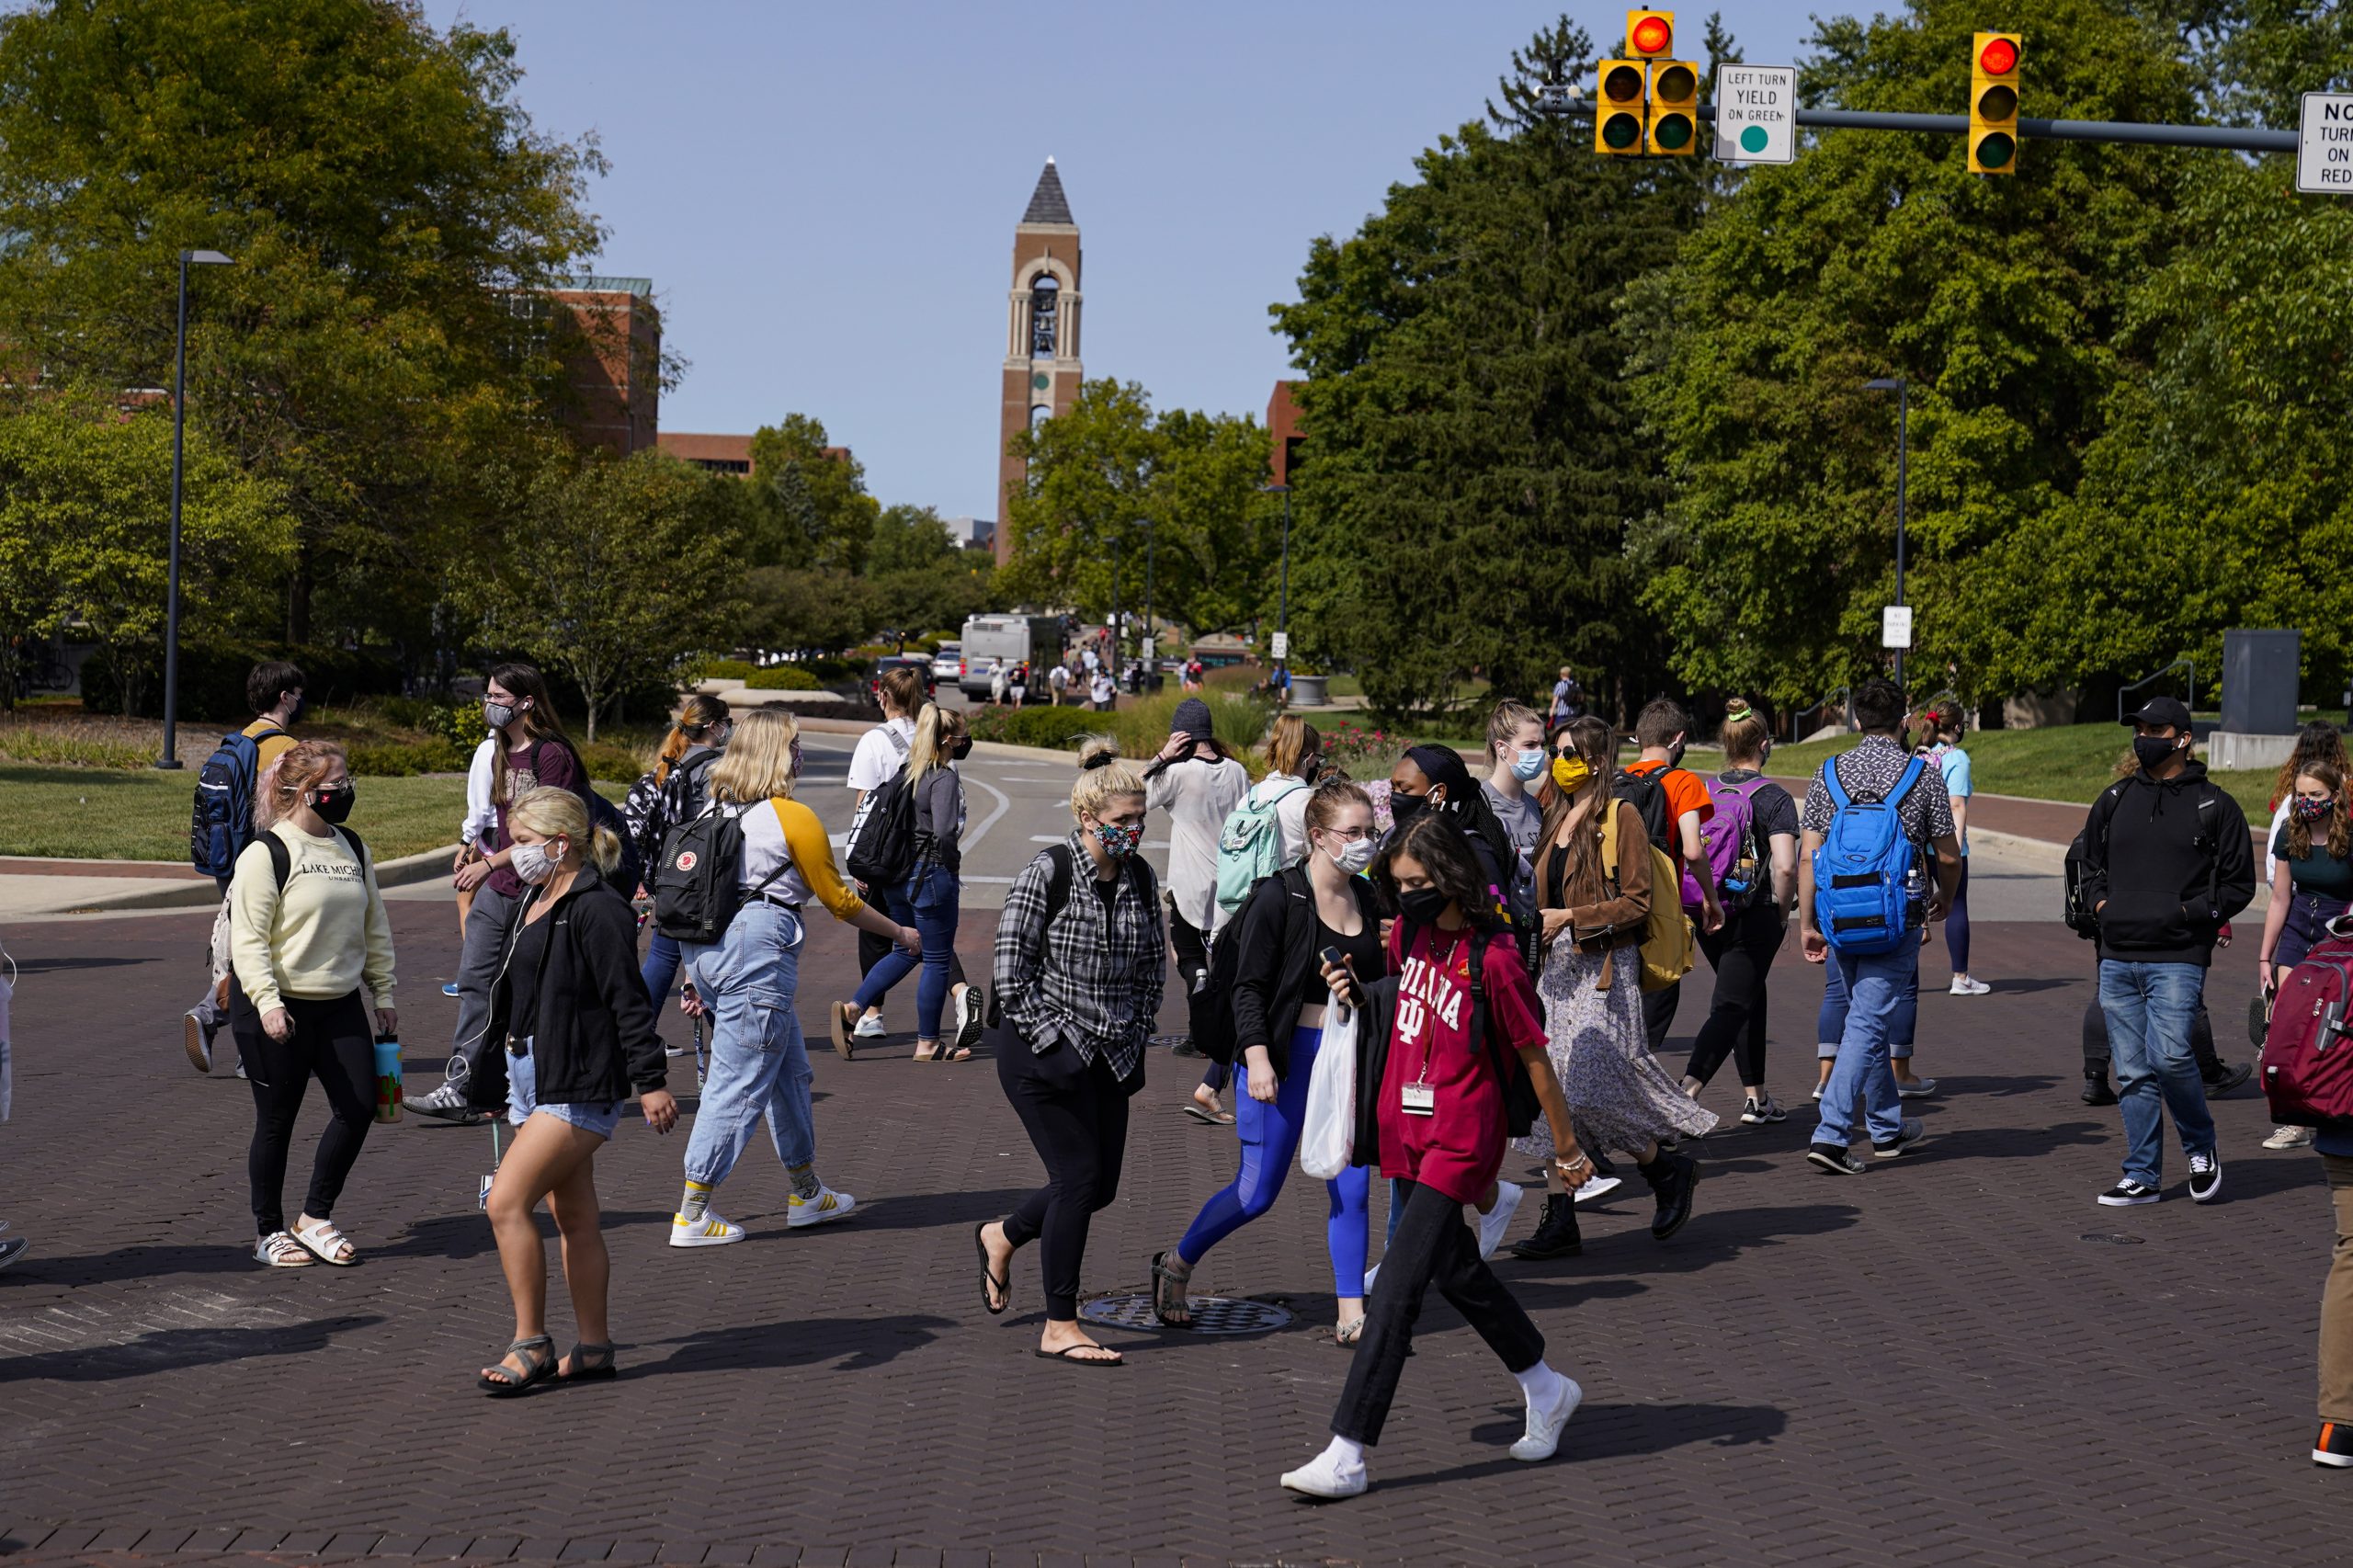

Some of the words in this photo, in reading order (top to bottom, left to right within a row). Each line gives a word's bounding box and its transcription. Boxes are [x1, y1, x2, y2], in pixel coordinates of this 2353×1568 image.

[1728, 73, 1754, 85] LEFT
[1758, 74, 1787, 85] TURN
[1737, 89, 1778, 105] YIELD
[1728, 108, 1744, 120] ON
[1748, 109, 1783, 121] GREEN
[2325, 103, 2353, 121] NO
[2320, 127, 2353, 142] TUR
[2328, 147, 2349, 162] ON
[2321, 168, 2352, 183] RED
[301, 863, 330, 874] LAKE
